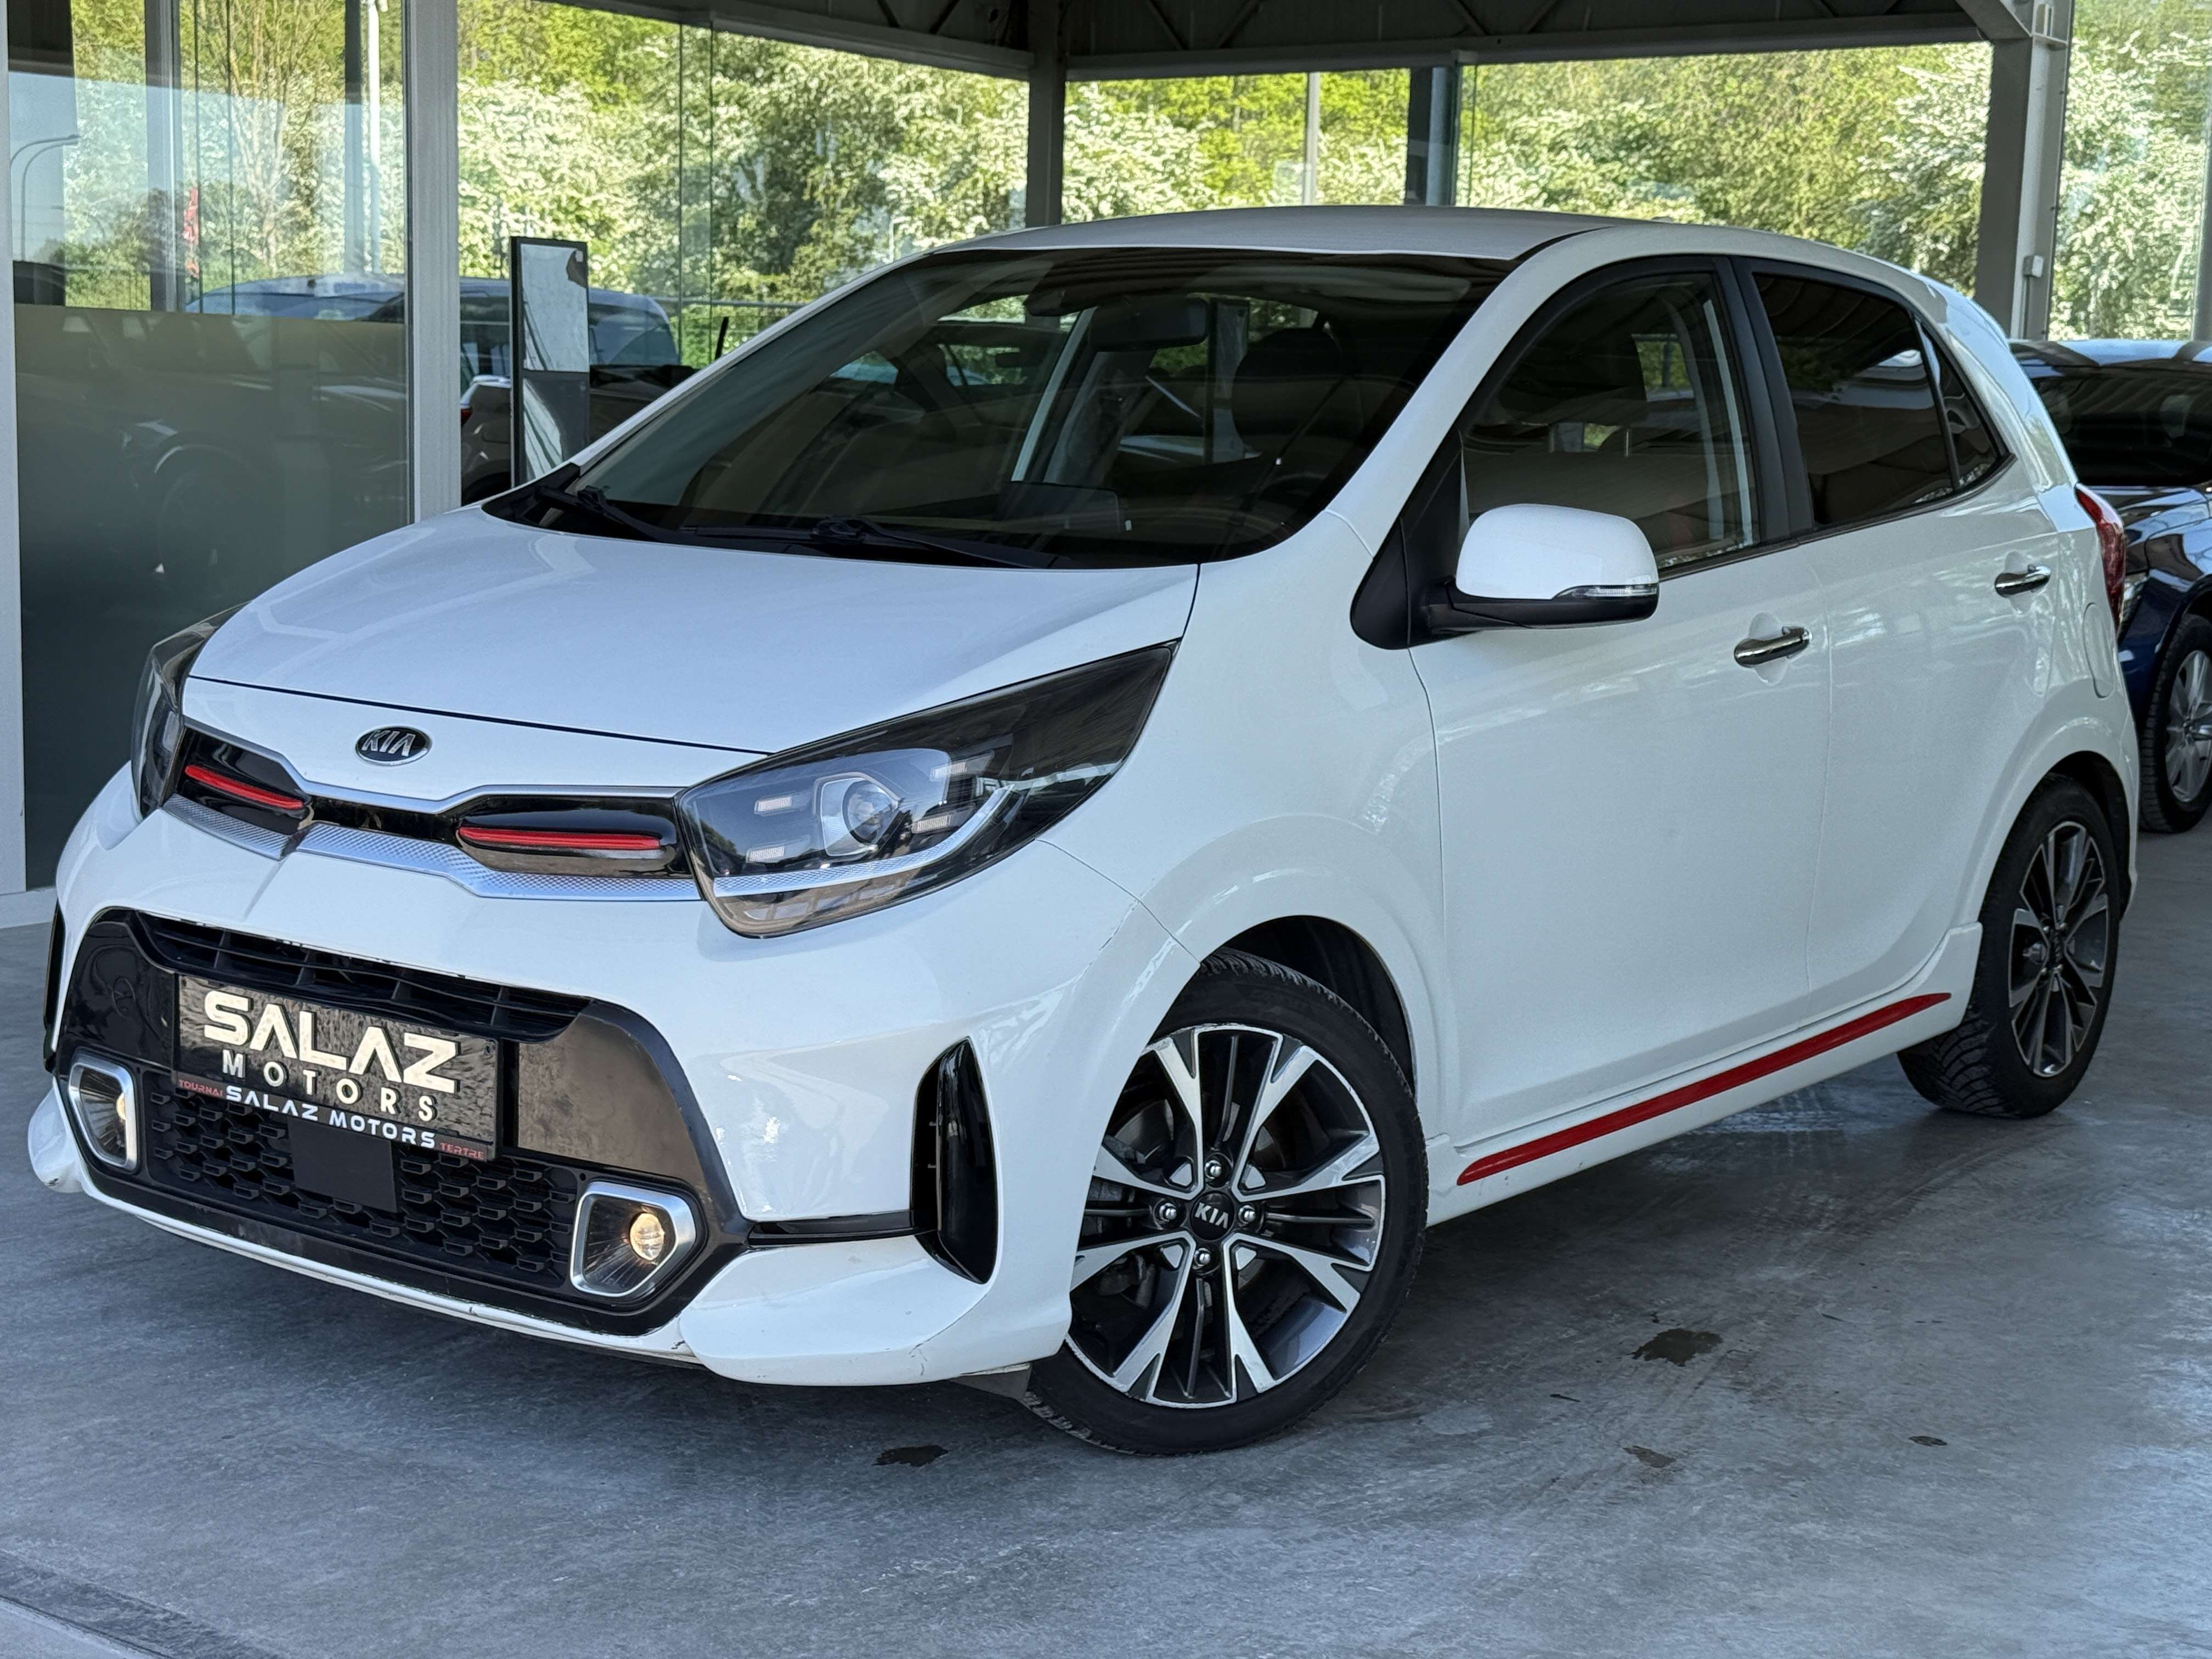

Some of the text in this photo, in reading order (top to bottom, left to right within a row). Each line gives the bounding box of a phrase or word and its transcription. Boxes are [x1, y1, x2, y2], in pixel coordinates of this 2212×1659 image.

[361, 730, 416, 757] KIA
[204, 990, 458, 1094] SALAZ
[178, 1079, 484, 1160] TOURNAI SALAZ MOTORS TERTRE
[222, 1049, 437, 1122] MOTORS
[1194, 1202, 1229, 1229] KIA
